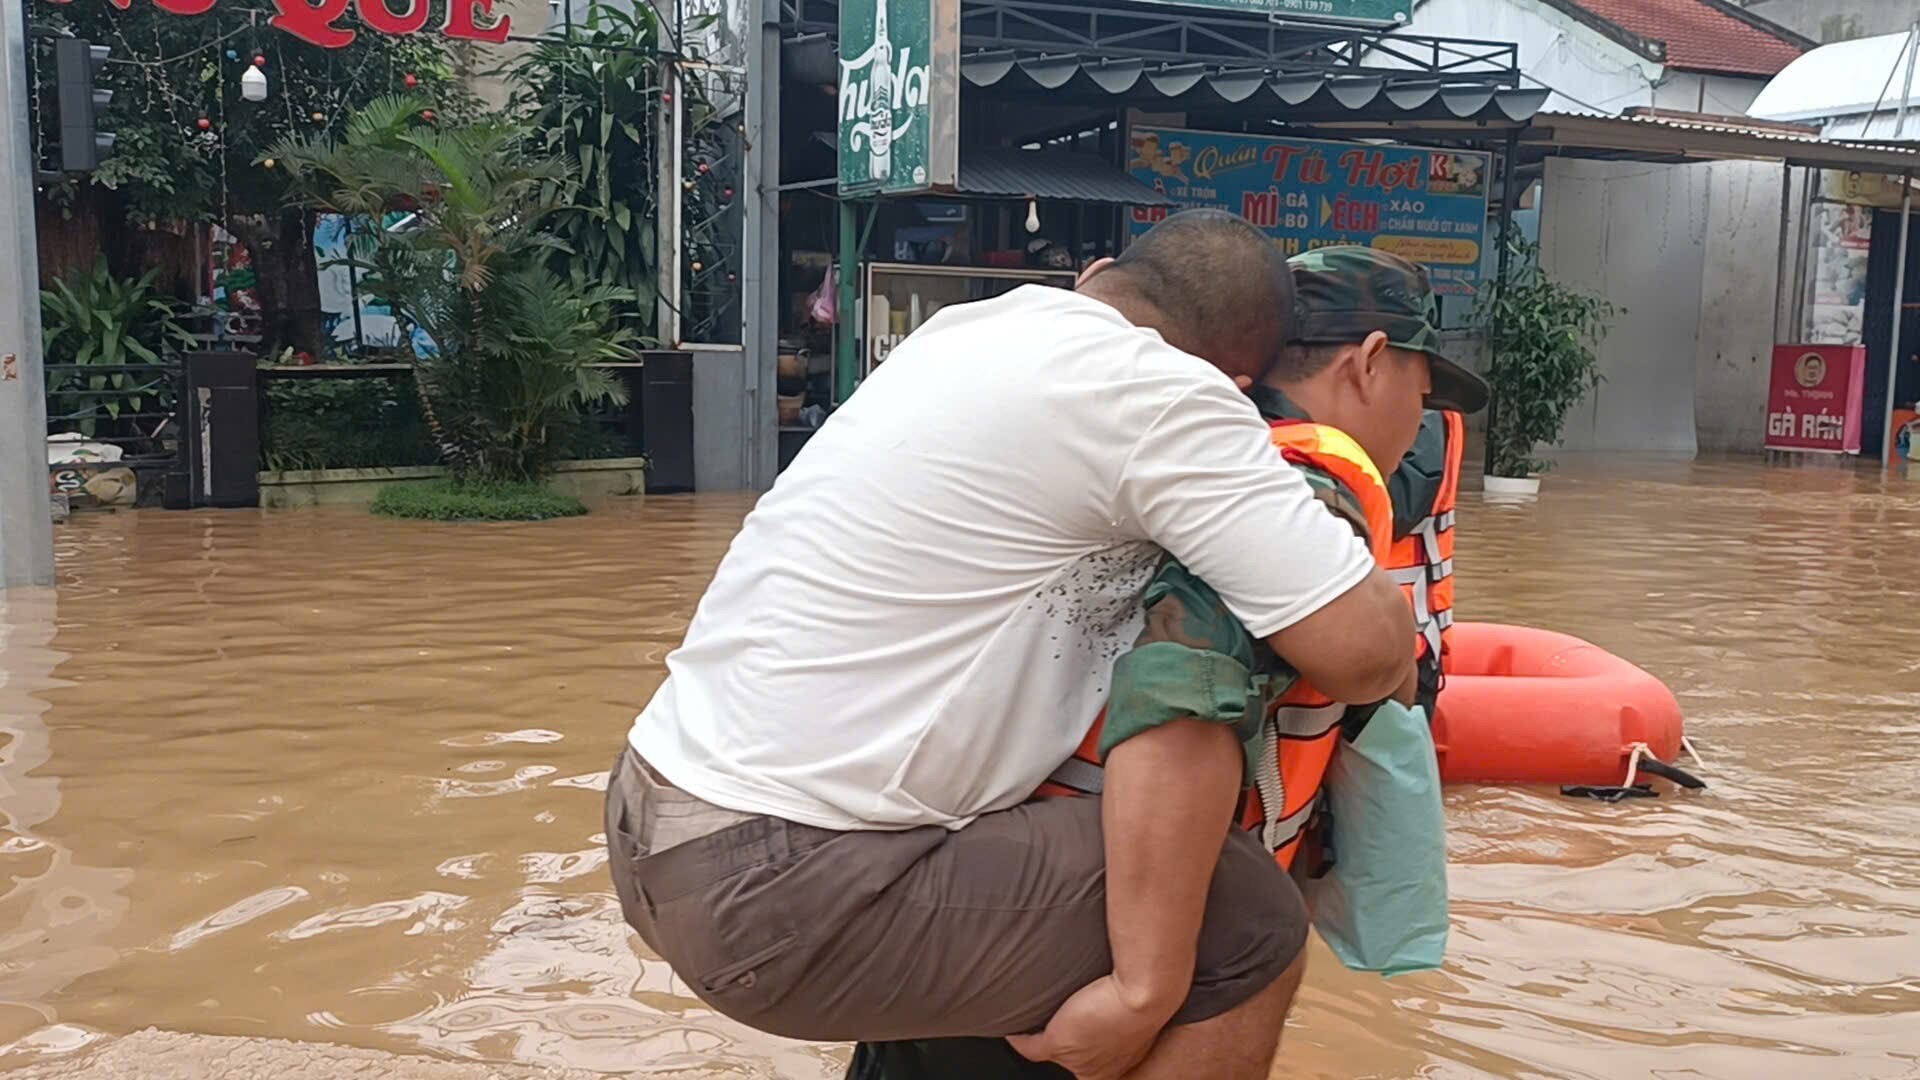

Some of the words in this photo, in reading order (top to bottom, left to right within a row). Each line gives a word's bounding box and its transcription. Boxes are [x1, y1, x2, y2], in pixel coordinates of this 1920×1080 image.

[1339, 150, 1424, 194] Hợi
[1242, 185, 1280, 228] MÌ
[1286, 190, 1308, 208] GÀ
[1768, 405, 1796, 437] GÀ
[1801, 407, 1844, 440] RÁN
